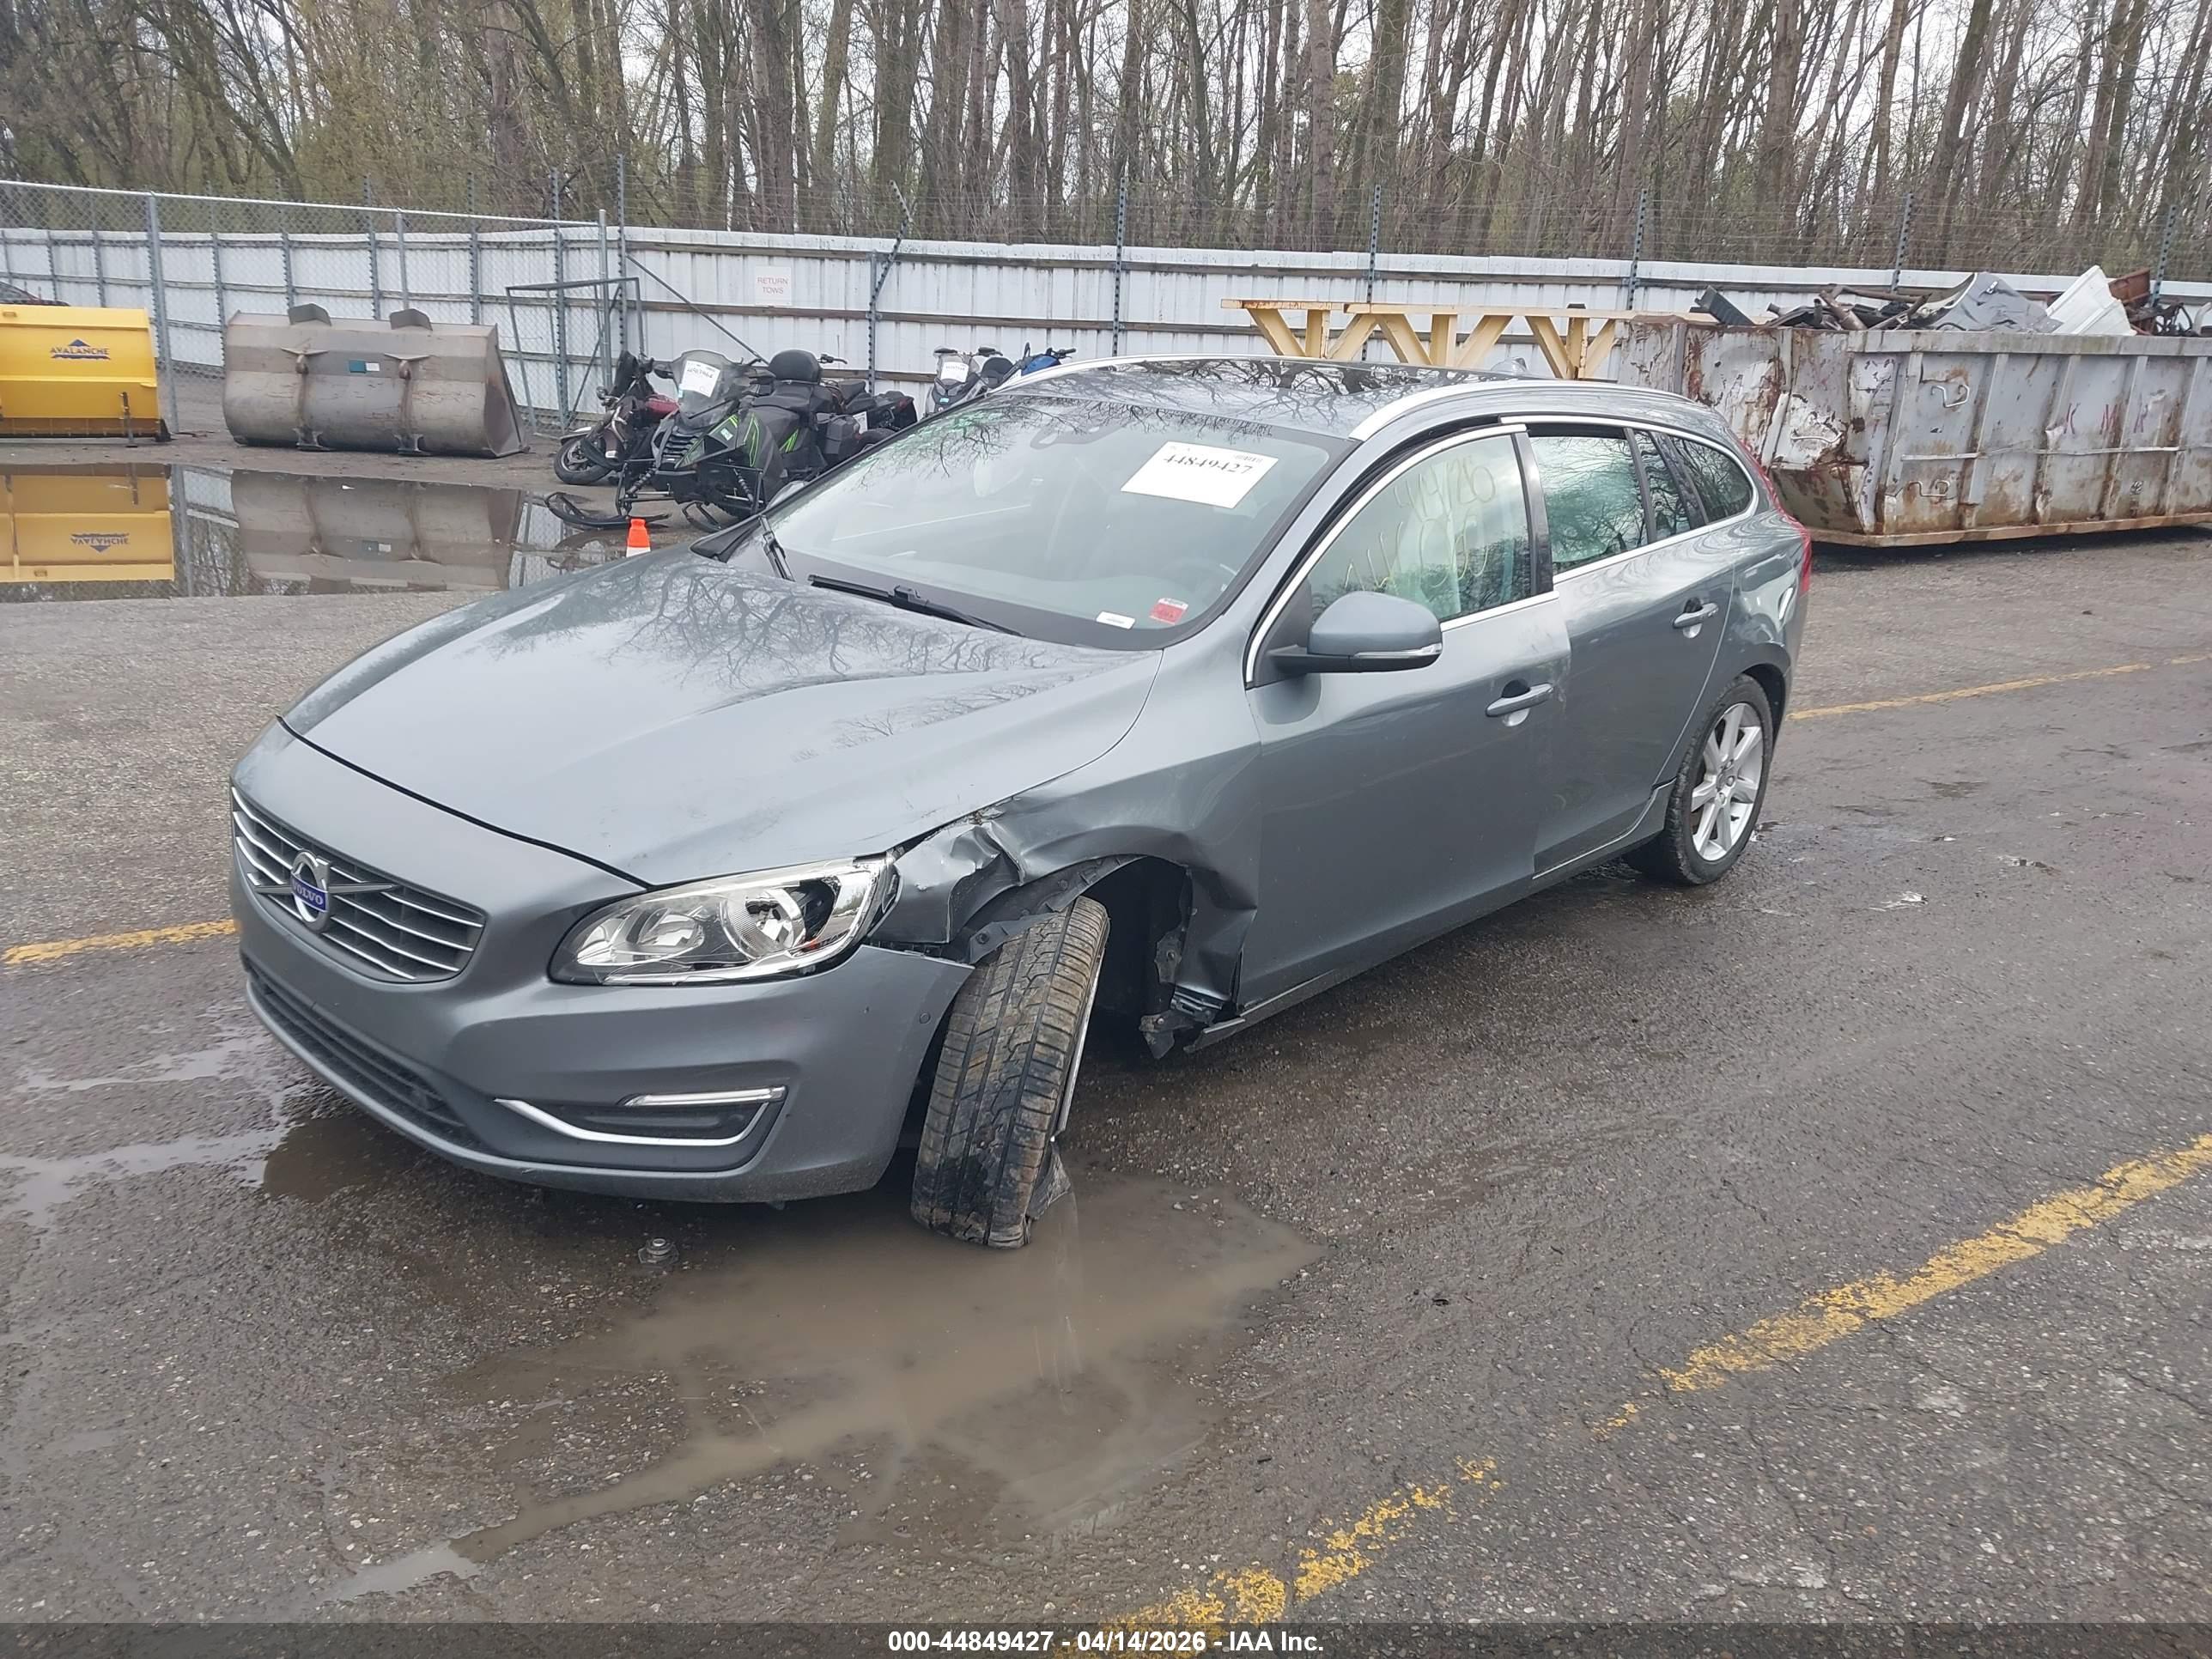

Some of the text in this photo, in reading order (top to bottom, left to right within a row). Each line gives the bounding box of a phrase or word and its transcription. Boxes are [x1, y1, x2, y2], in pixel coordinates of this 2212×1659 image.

[763, 286, 784, 295] TOWS
[50, 347, 110, 356] AVALANCHE
[1164, 453, 1253, 475] 44849427
[293, 880, 324, 906] VOLVO
